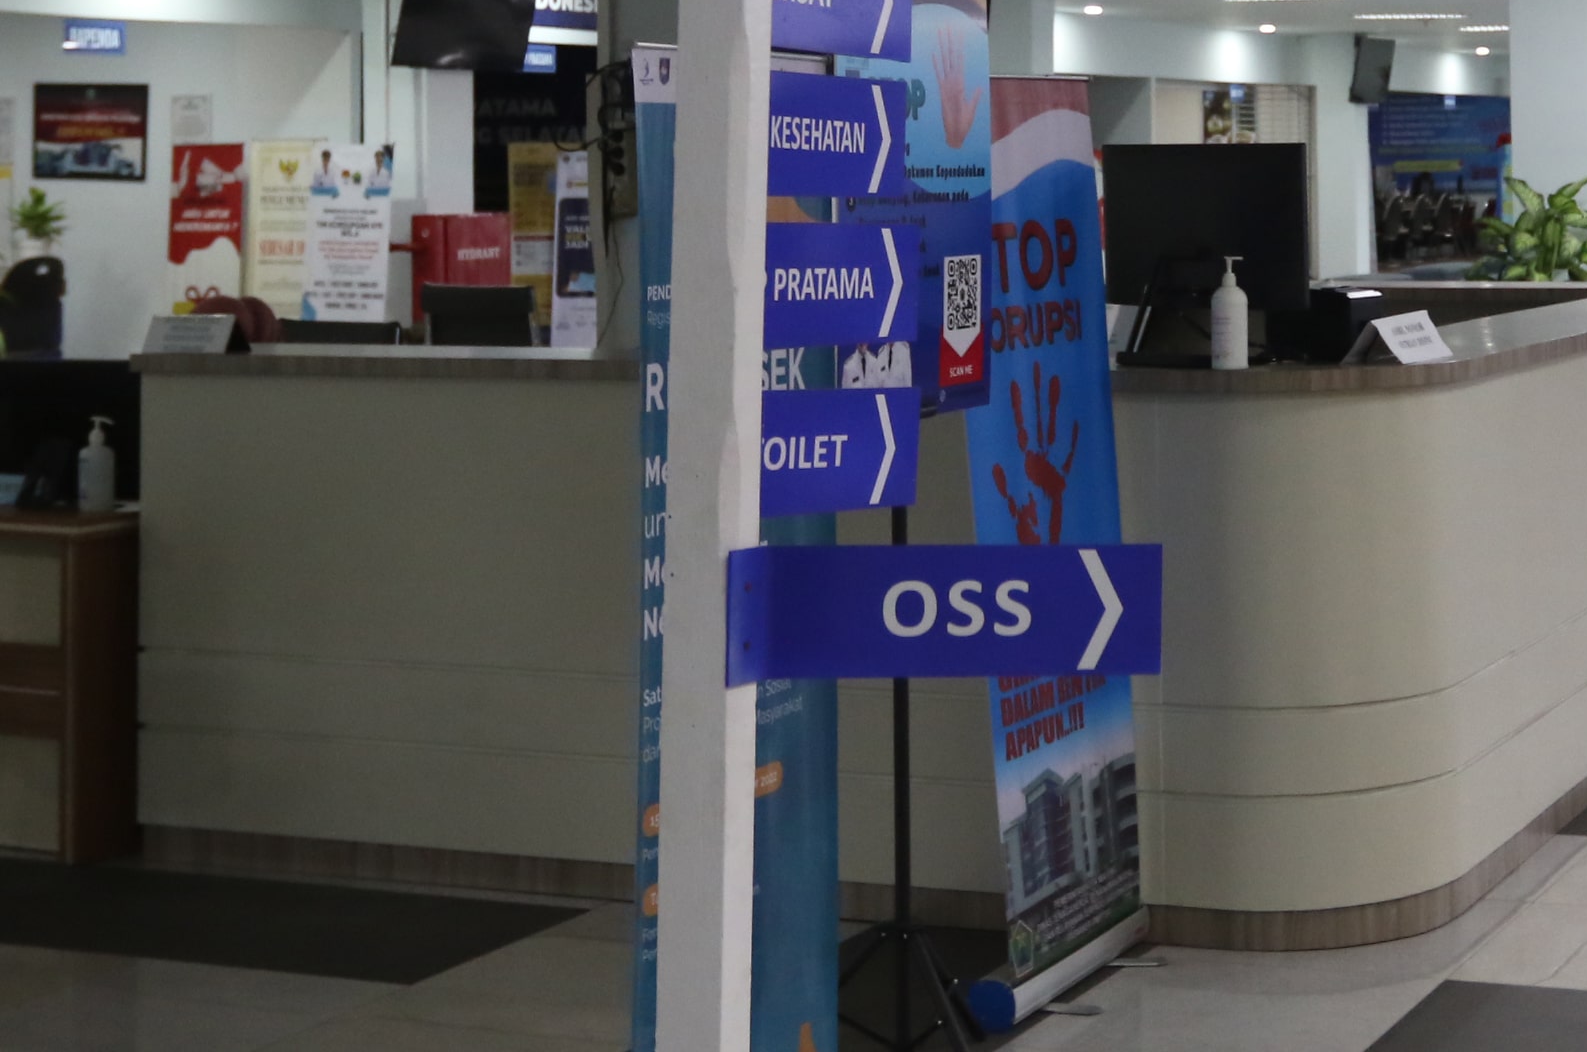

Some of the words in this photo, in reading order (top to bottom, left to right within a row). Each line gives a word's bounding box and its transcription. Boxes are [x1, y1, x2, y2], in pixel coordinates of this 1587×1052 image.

[770, 115, 866, 154] KESEHATAN
[991, 218, 1078, 294] TOP
[774, 267, 874, 302] PRATAMA
[762, 434, 849, 471] OILET
[881, 580, 1032, 638] OSS
[1000, 681, 1055, 728] DALAM
